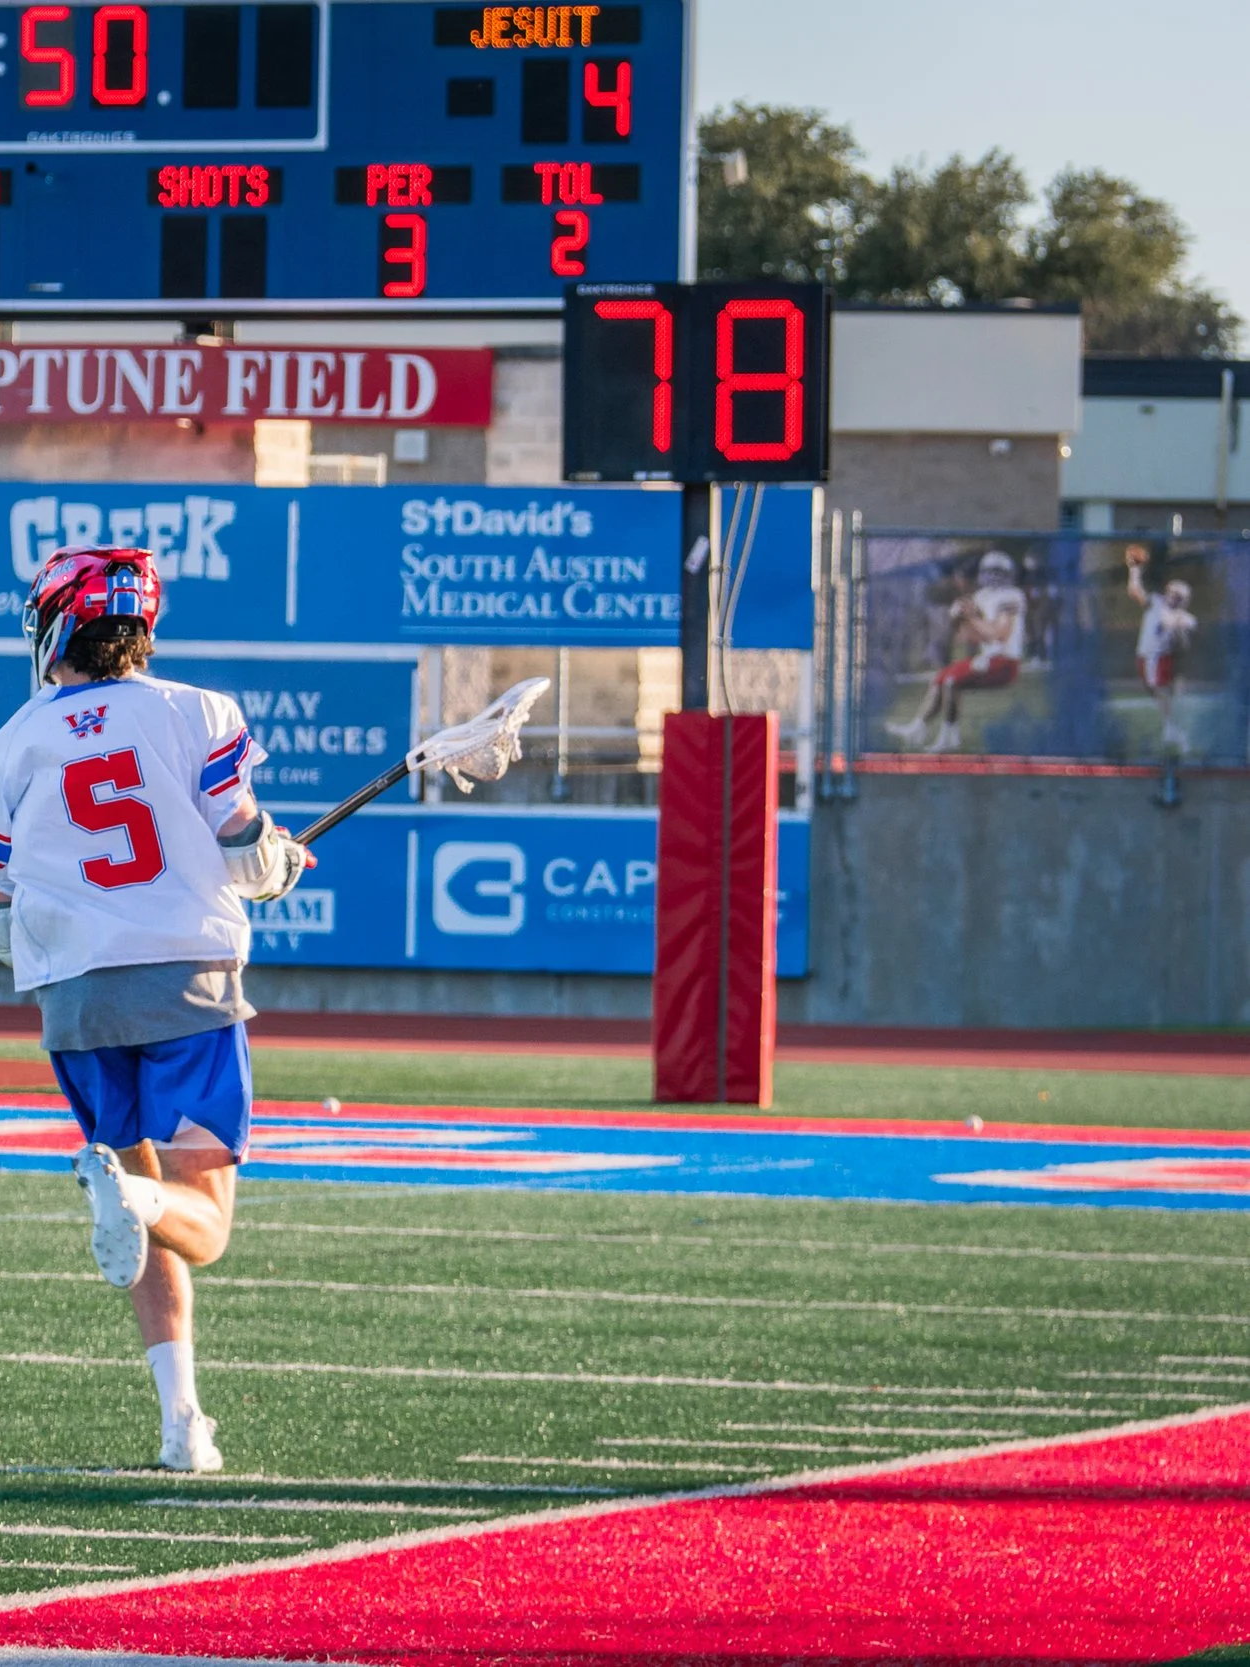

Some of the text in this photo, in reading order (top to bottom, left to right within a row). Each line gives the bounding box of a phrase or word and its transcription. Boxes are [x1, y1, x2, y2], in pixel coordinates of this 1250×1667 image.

[471, 5, 600, 48] JESUIT
[584, 61, 632, 136] 4
[157, 164, 270, 207] SHOTS
[366, 163, 433, 206] PER
[534, 162, 604, 205] TOL
[383, 213, 427, 297] 3
[550, 210, 590, 276] 2
[221, 350, 438, 418] FIELD
[594, 300, 803, 461] 78
[400, 543, 646, 583] SOUTH AUSTIN
[401, 580, 682, 620] MEDICAL CENTE
[253, 724, 388, 756] IANCES
[61, 746, 166, 890] 5
[543, 857, 659, 897] CAP
